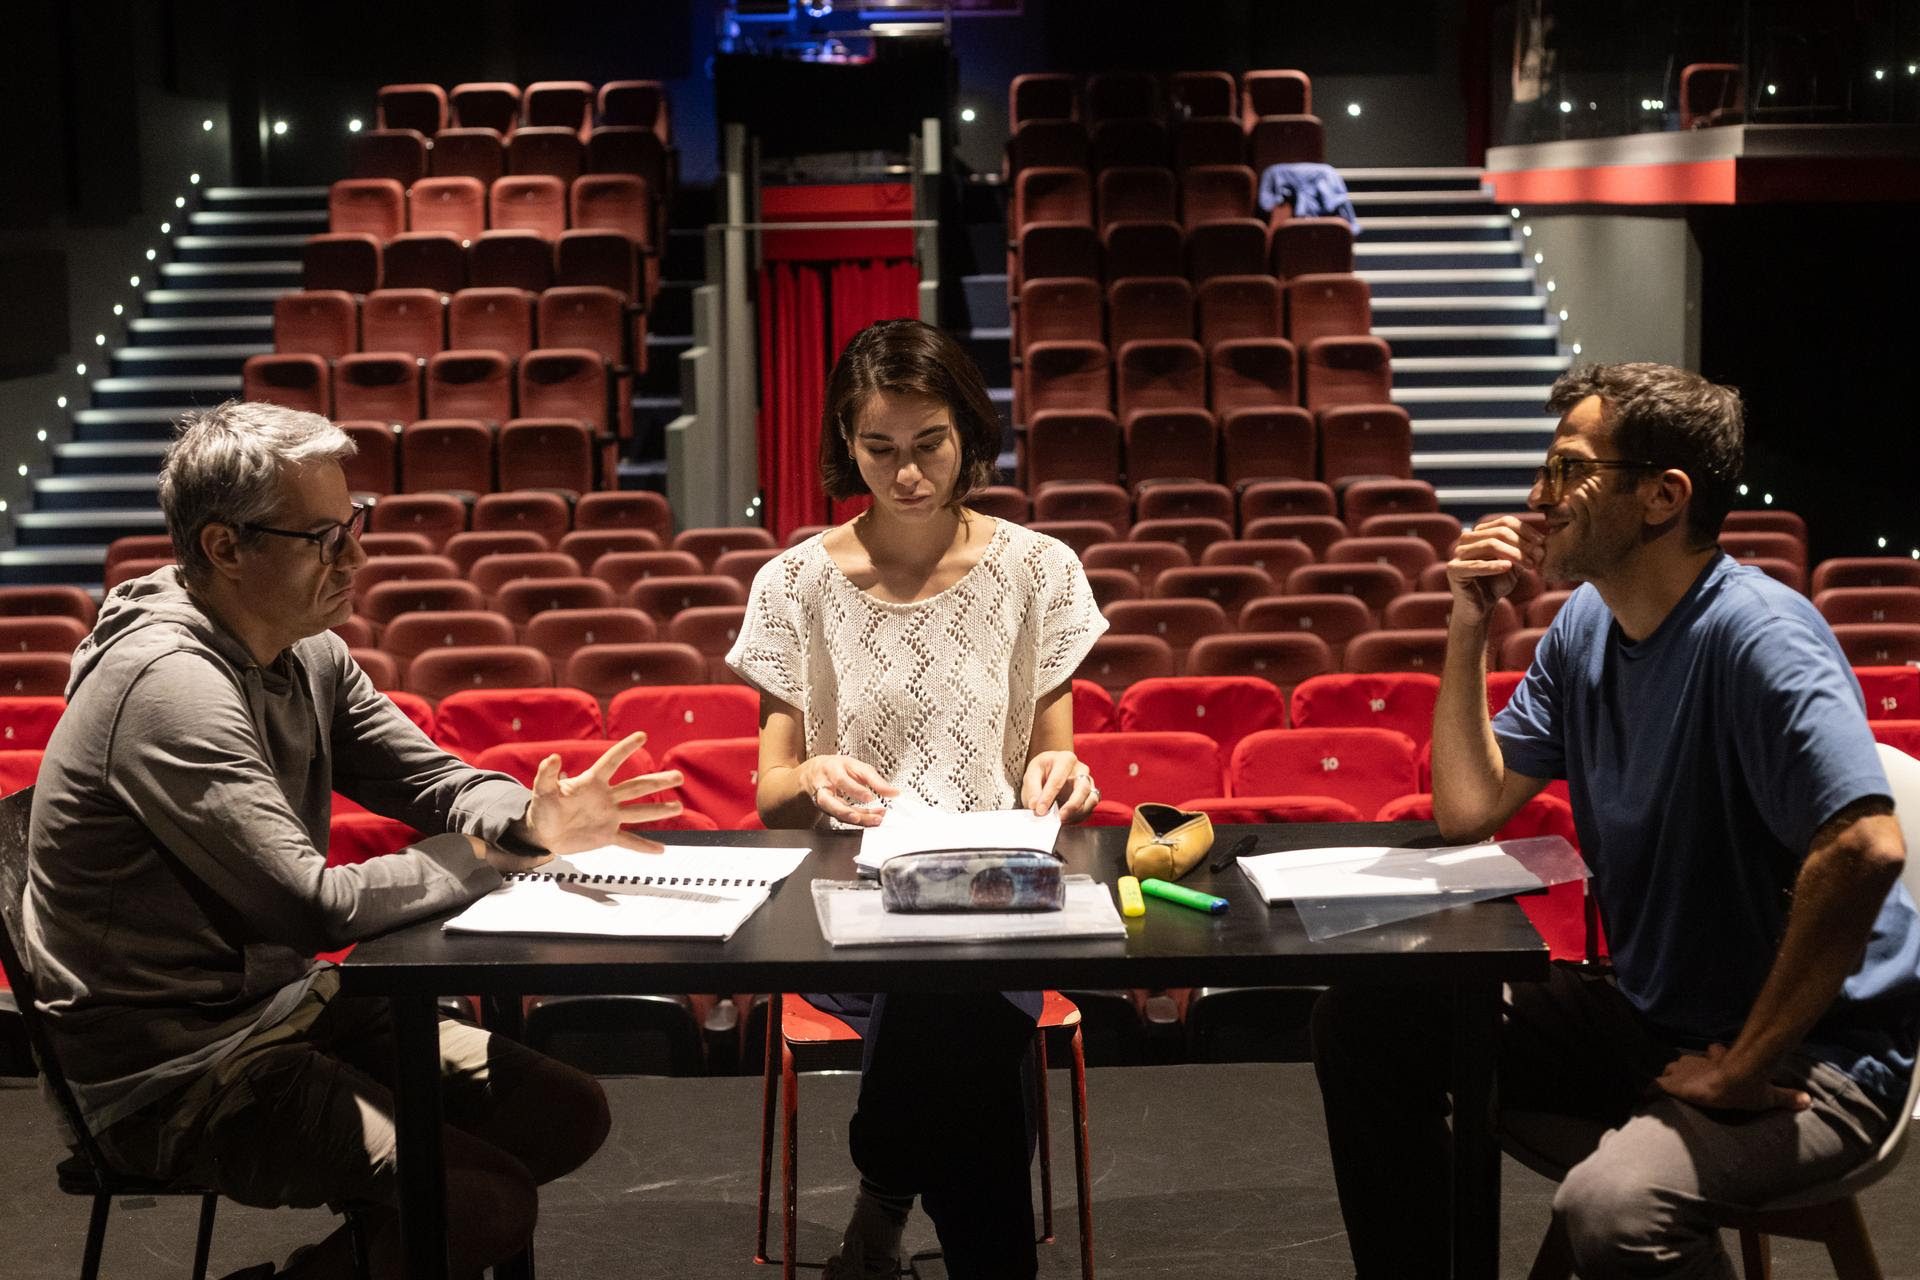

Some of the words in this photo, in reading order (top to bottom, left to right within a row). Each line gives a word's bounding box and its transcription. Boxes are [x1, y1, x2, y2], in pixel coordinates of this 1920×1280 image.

[1368, 697, 1386, 712] 10
[1880, 696, 1898, 711] 13
[4, 725, 15, 739] 2
[1128, 762, 1139, 776] 9
[1320, 756, 1340, 772] 10
[749, 769, 759, 785] 7
